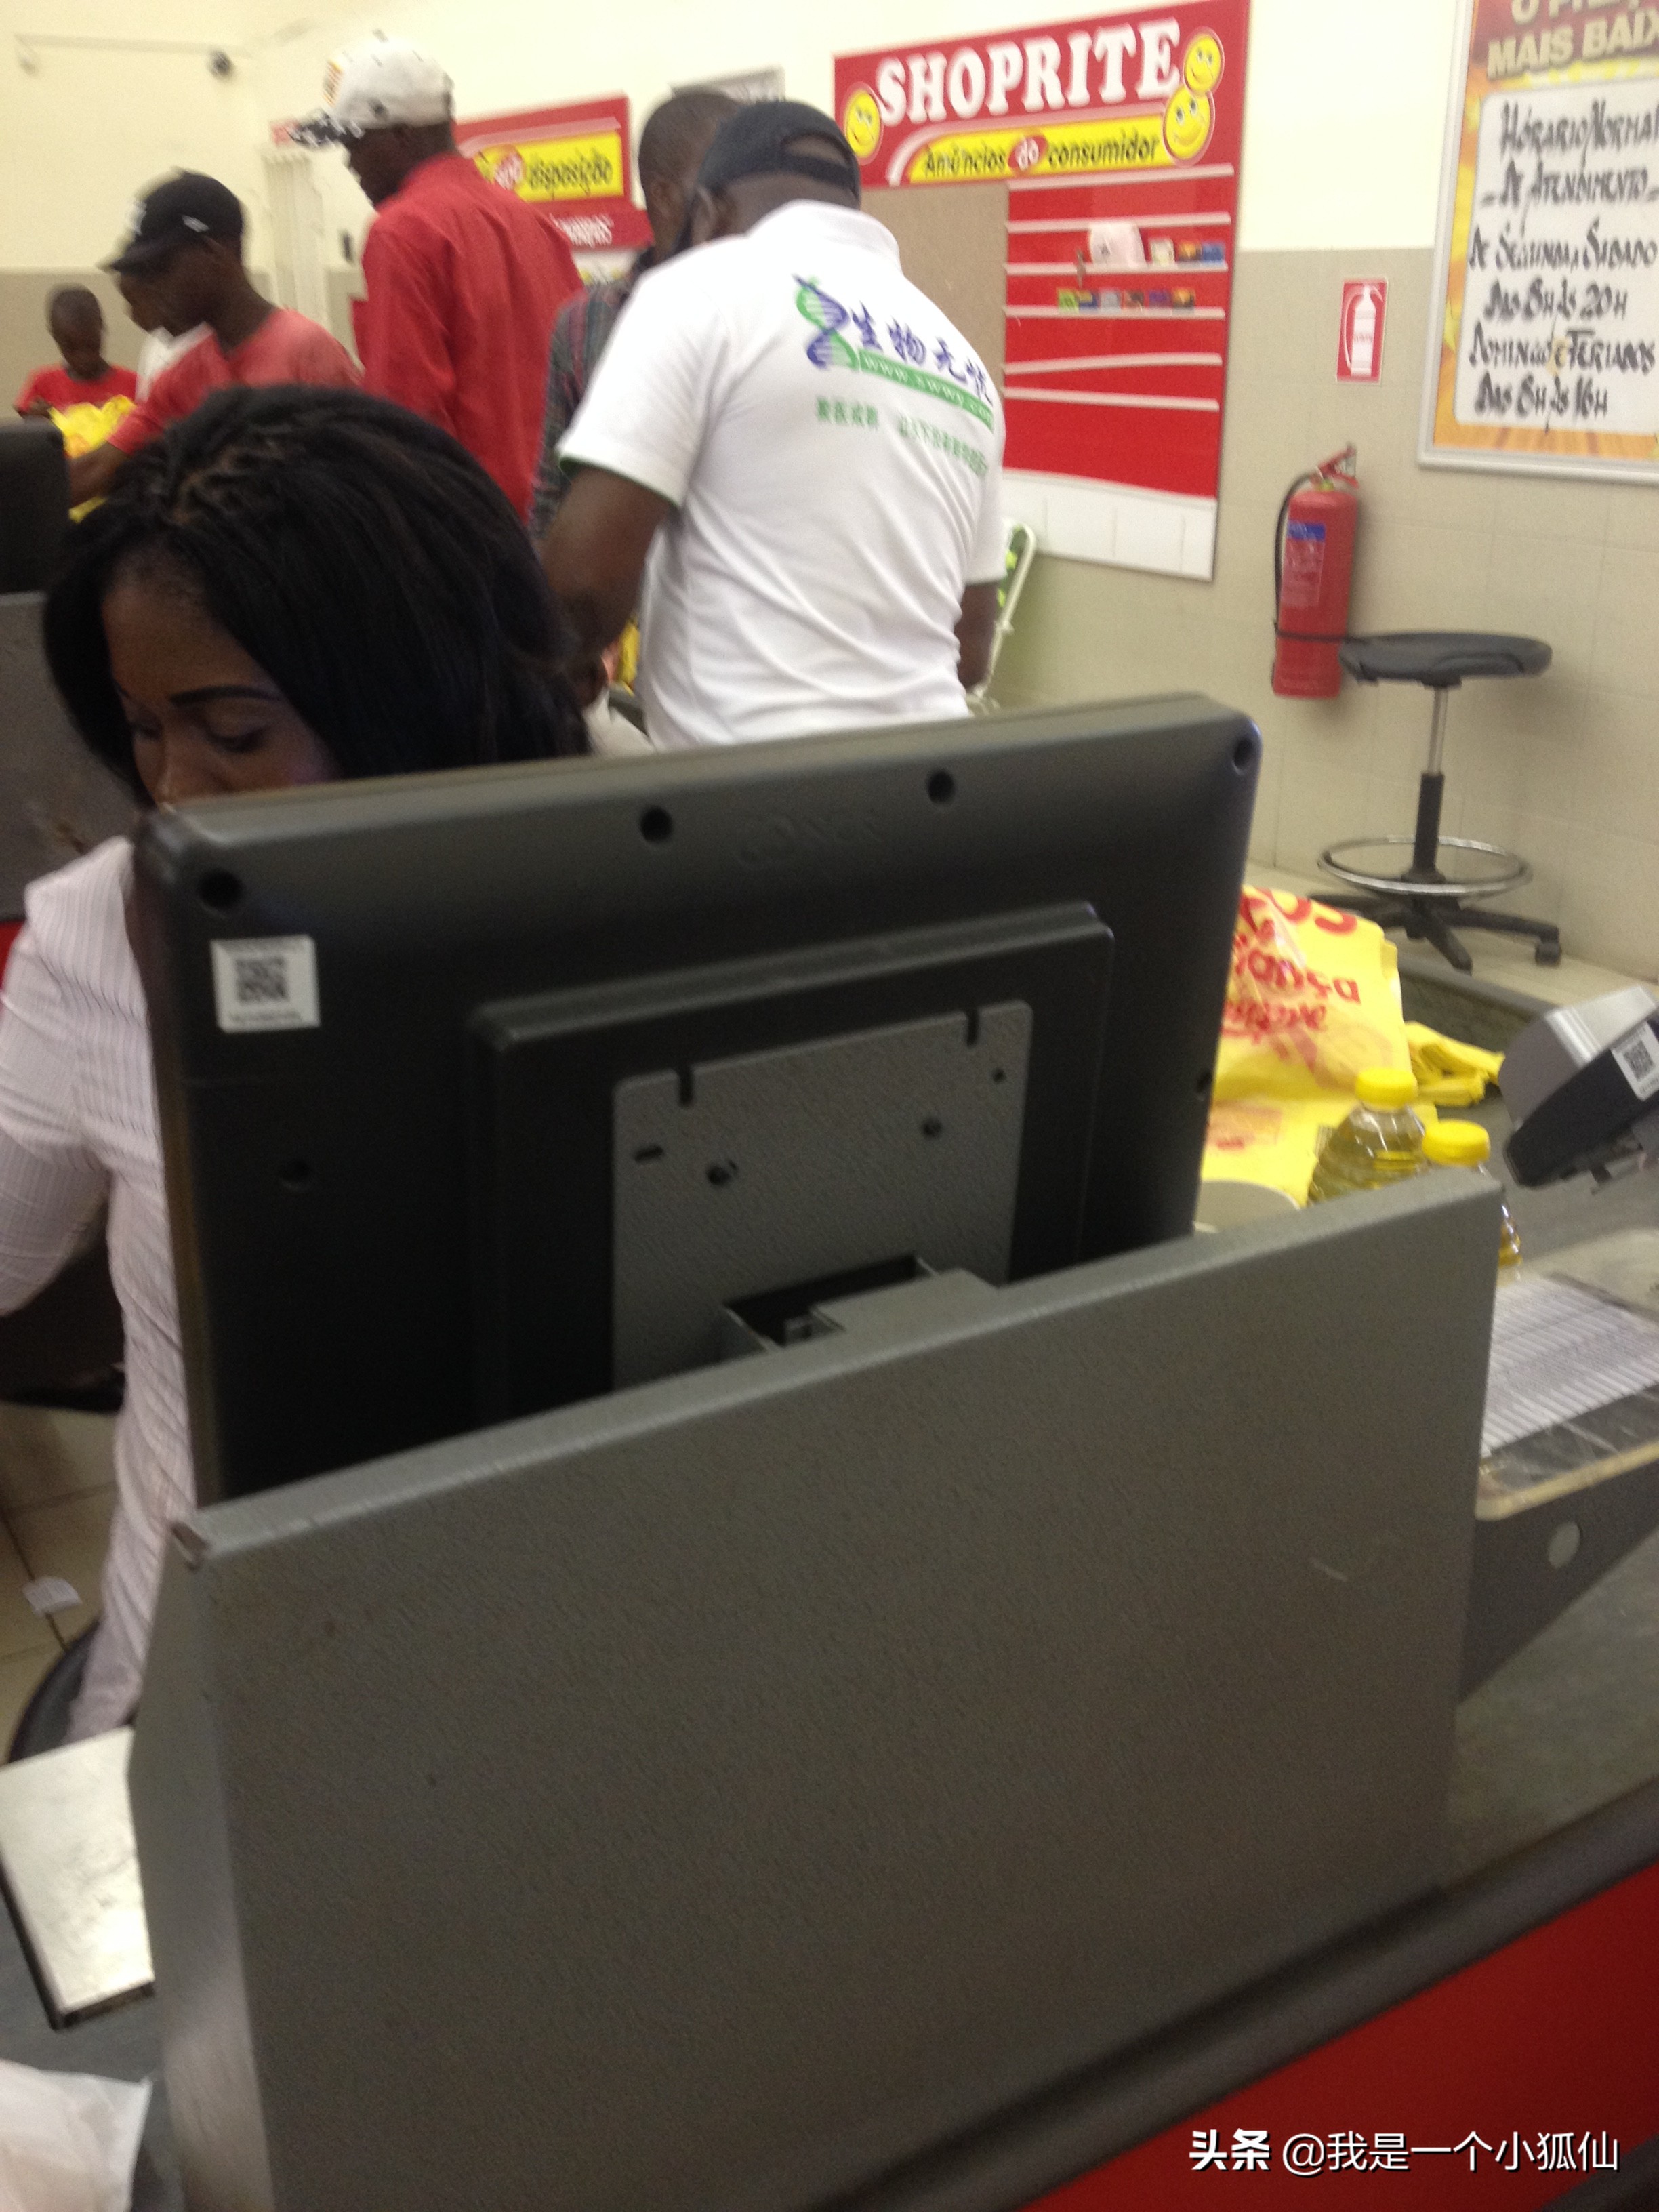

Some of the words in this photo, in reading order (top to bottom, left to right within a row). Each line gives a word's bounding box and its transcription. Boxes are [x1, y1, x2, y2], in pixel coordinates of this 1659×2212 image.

[876, 18, 1180, 126] SHOPRITE
[1488, 25, 1574, 78] MAIS
[1048, 127, 1160, 168] consumidor
